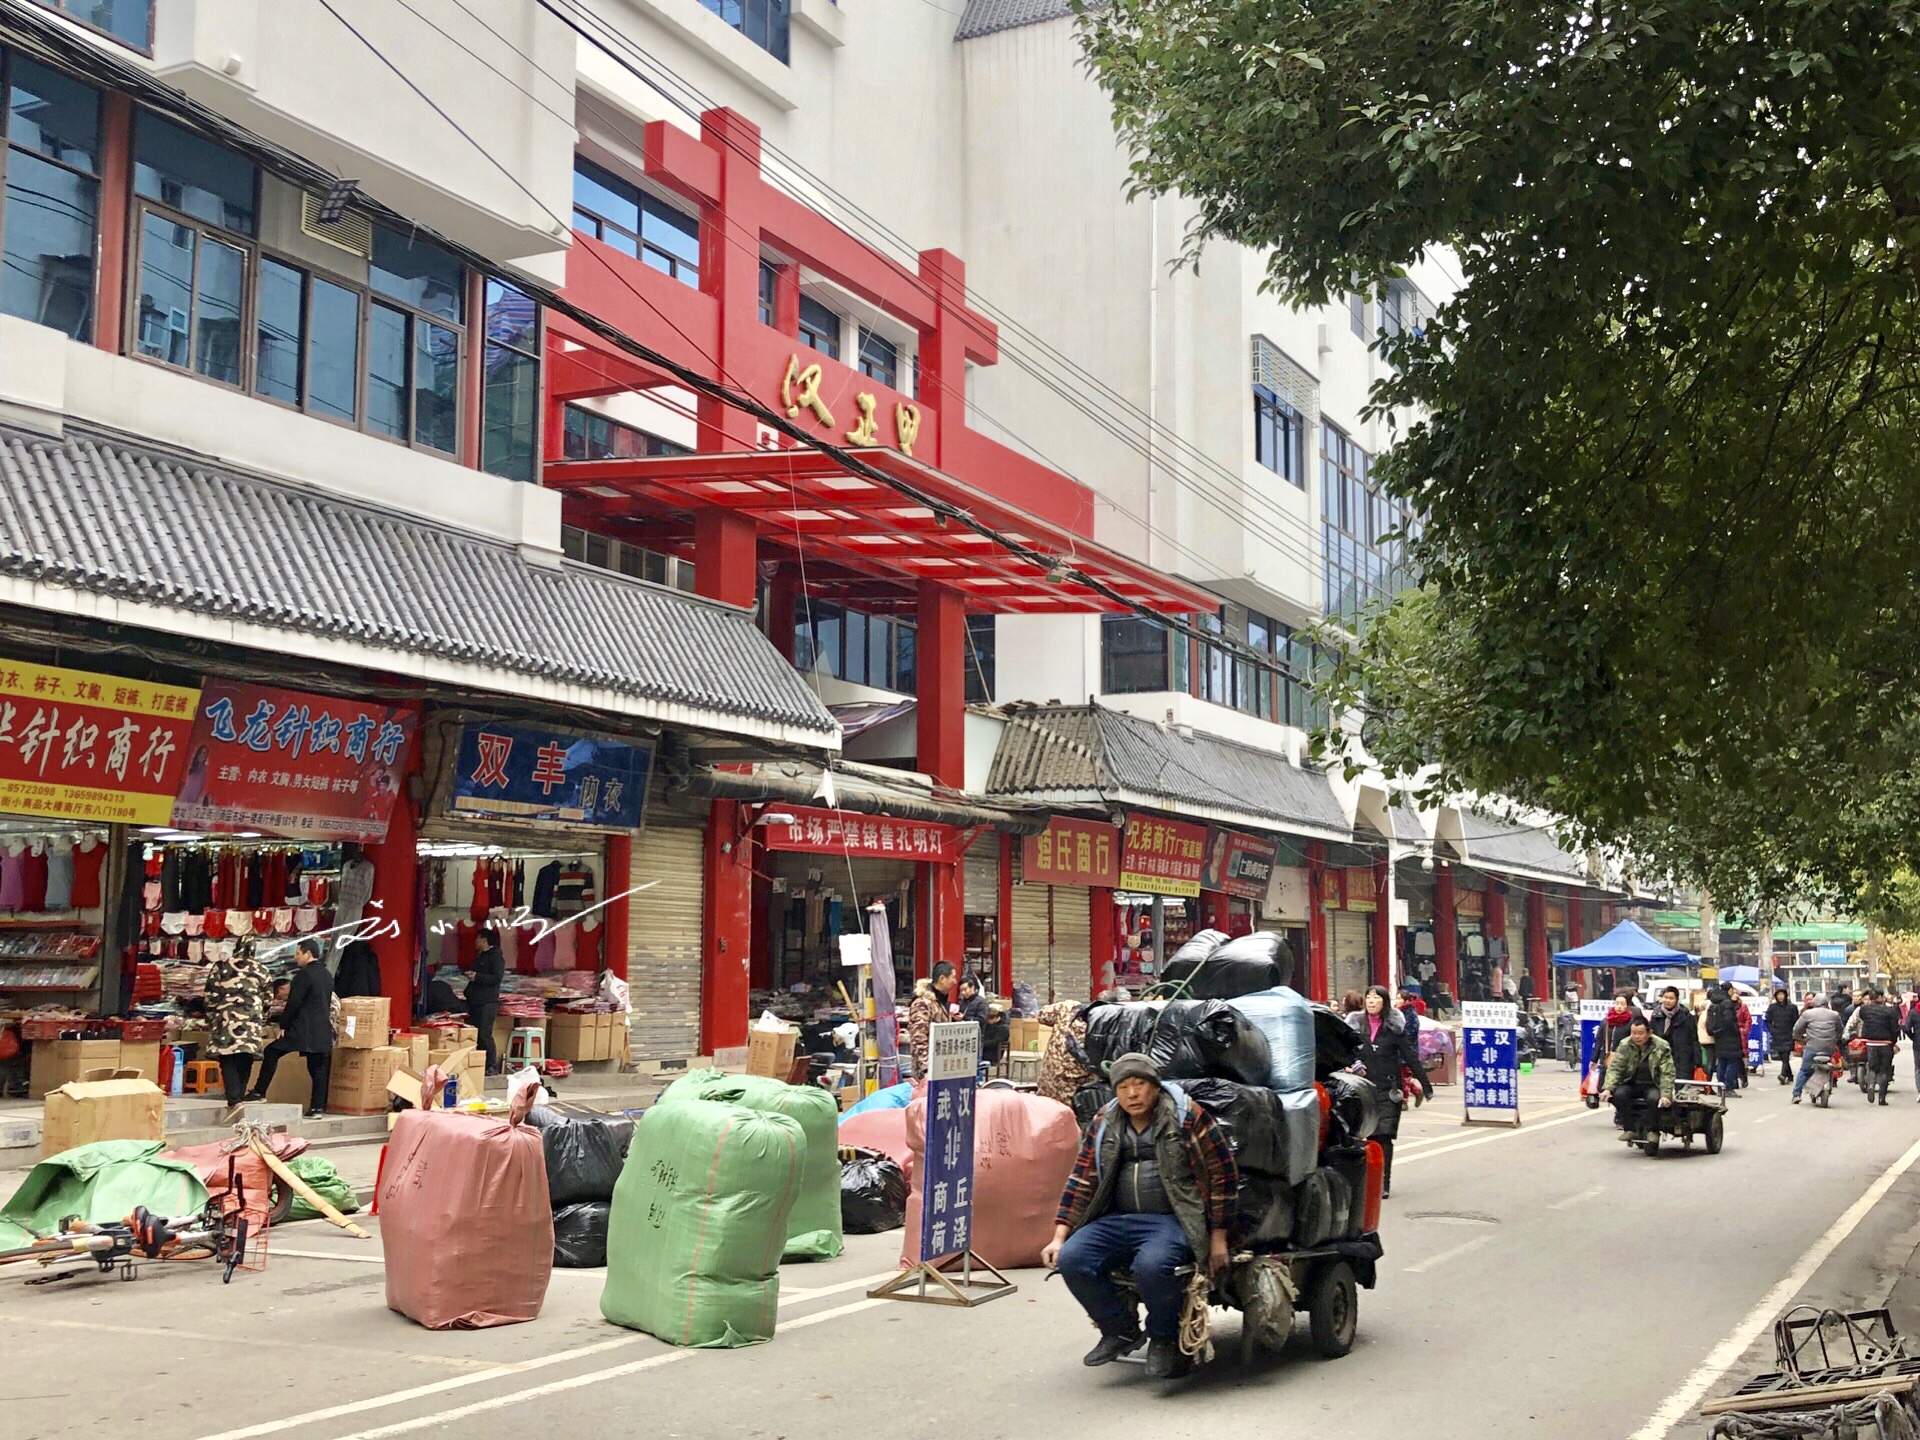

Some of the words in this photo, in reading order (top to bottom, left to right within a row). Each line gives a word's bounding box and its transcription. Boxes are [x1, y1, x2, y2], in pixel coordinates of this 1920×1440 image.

[206, 697, 405, 765] 飞龙针织商行
[247, 768, 268, 783] 内衣
[471, 732, 567, 795] 双丰
[579, 775, 623, 812] 内衣
[788, 815, 942, 854] 市场严禁销售孔明灯
[1128, 821, 1176, 855] 兄弟商行
[1470, 1030, 1510, 1045] 武汉
[1474, 1067, 1486, 1104] 沈阳
[1486, 1067, 1497, 1105] 长春
[1497, 1068, 1509, 1105] 深圳
[936, 1088, 972, 1121] 武汉
[933, 1177, 969, 1215] 商丘
